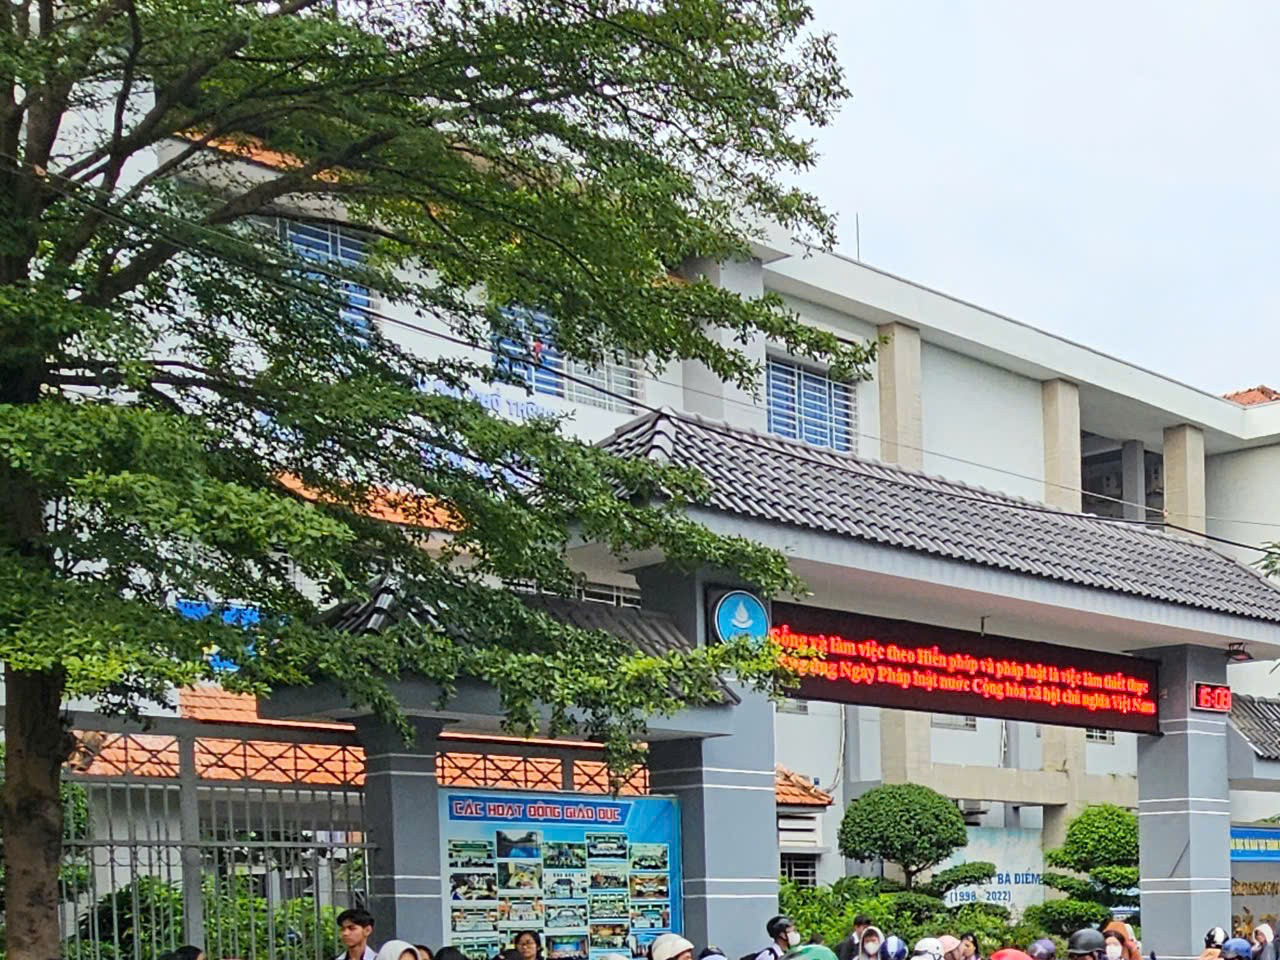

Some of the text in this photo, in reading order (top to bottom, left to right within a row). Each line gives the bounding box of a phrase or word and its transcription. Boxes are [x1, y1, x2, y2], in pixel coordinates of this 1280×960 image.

[830, 636, 857, 656] làm
[858, 640, 885, 662] việc
[886, 644, 916, 663] theo
[917, 645, 947, 667] Hiến
[947, 653, 978, 675] pháp
[980, 657, 994, 673] và
[996, 660, 1024, 681] pháp
[1025, 663, 1047, 683] luật
[1049, 667, 1060, 682] là
[1060, 667, 1082, 688] việc
[1082, 671, 1102, 688] làm
[840, 661, 875, 684] Ngày
[877, 665, 911, 688] Pháp
[912, 669, 938, 691] luật
[939, 674, 970, 691] nước
[972, 677, 1004, 700] Cộng
[1027, 685, 1042, 700] xã
[1043, 686, 1060, 706] hội
[1112, 694, 1131, 713] Việt
[1132, 698, 1156, 714] Nam
[454, 799, 483, 816] CÁC
[487, 802, 523, 820] HOẠT
[527, 801, 561, 820] ĐỘNG
[564, 804, 594, 820] GIÁO
